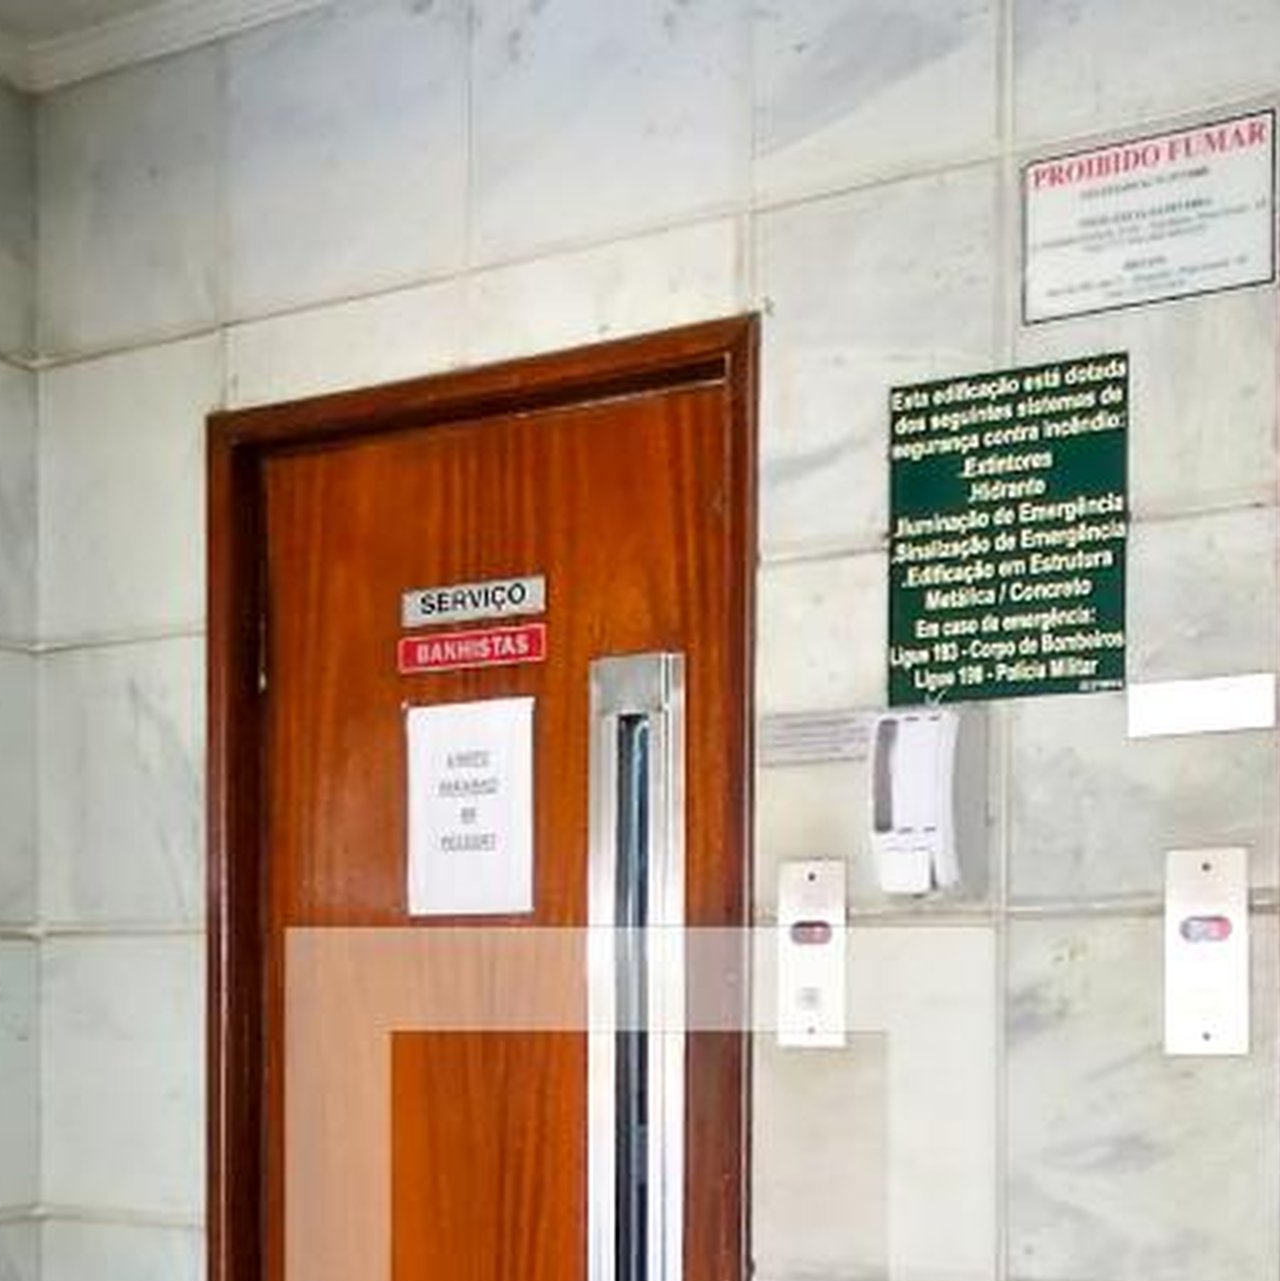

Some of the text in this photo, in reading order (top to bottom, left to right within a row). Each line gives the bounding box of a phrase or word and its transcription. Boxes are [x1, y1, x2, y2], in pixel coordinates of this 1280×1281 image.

[1032, 146, 1160, 189] PROIBIDO
[1168, 121, 1267, 161] FUMAR
[932, 379, 1019, 402] edificação
[930, 401, 1012, 430] seguintes
[1017, 391, 1095, 417] sistemas
[892, 434, 980, 461] segurança
[982, 427, 1038, 447] contra
[993, 506, 1015, 526] de
[1019, 492, 1124, 521] Emergência
[994, 532, 1016, 552] de
[1021, 520, 1126, 549] Emergência
[998, 560, 1026, 577] em
[1030, 548, 1113, 574] Estrutura
[421, 583, 526, 614] SERVIÇO
[924, 584, 995, 610] Metálica
[1009, 577, 1093, 602] Concreto
[942, 615, 978, 635] caso
[416, 633, 530, 664] BANHISTAS
[970, 639, 1016, 661] Corpo
